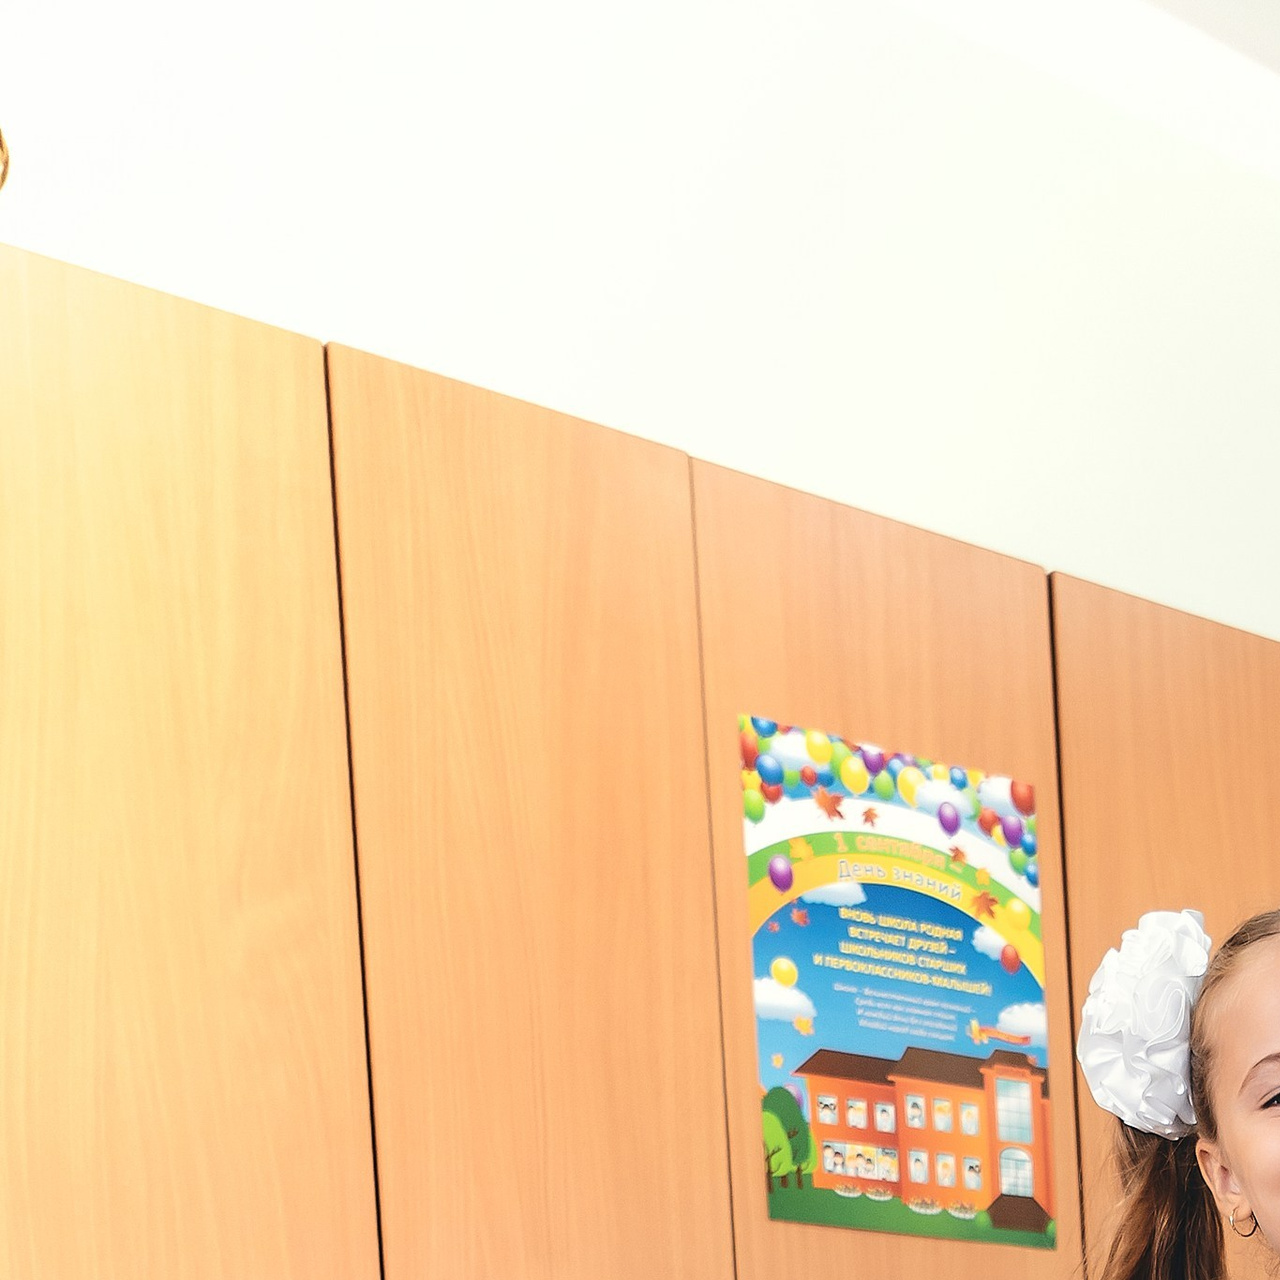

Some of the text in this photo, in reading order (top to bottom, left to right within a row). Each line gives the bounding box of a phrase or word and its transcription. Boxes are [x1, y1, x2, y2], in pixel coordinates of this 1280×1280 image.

[834, 832, 848, 852] 1
[839, 859, 961, 900] День знаний
[839, 907, 963, 942] ВНОВЬ ШКОЛА РОДНАЯ
[848, 926, 905, 947] ВСТРЕЧАЕТ
[908, 937, 948, 955] ДРУЗЕЙ
[813, 953, 823, 966] И
[839, 941, 967, 975] ШКОЛЬНИКОВ СТАРШИХ
